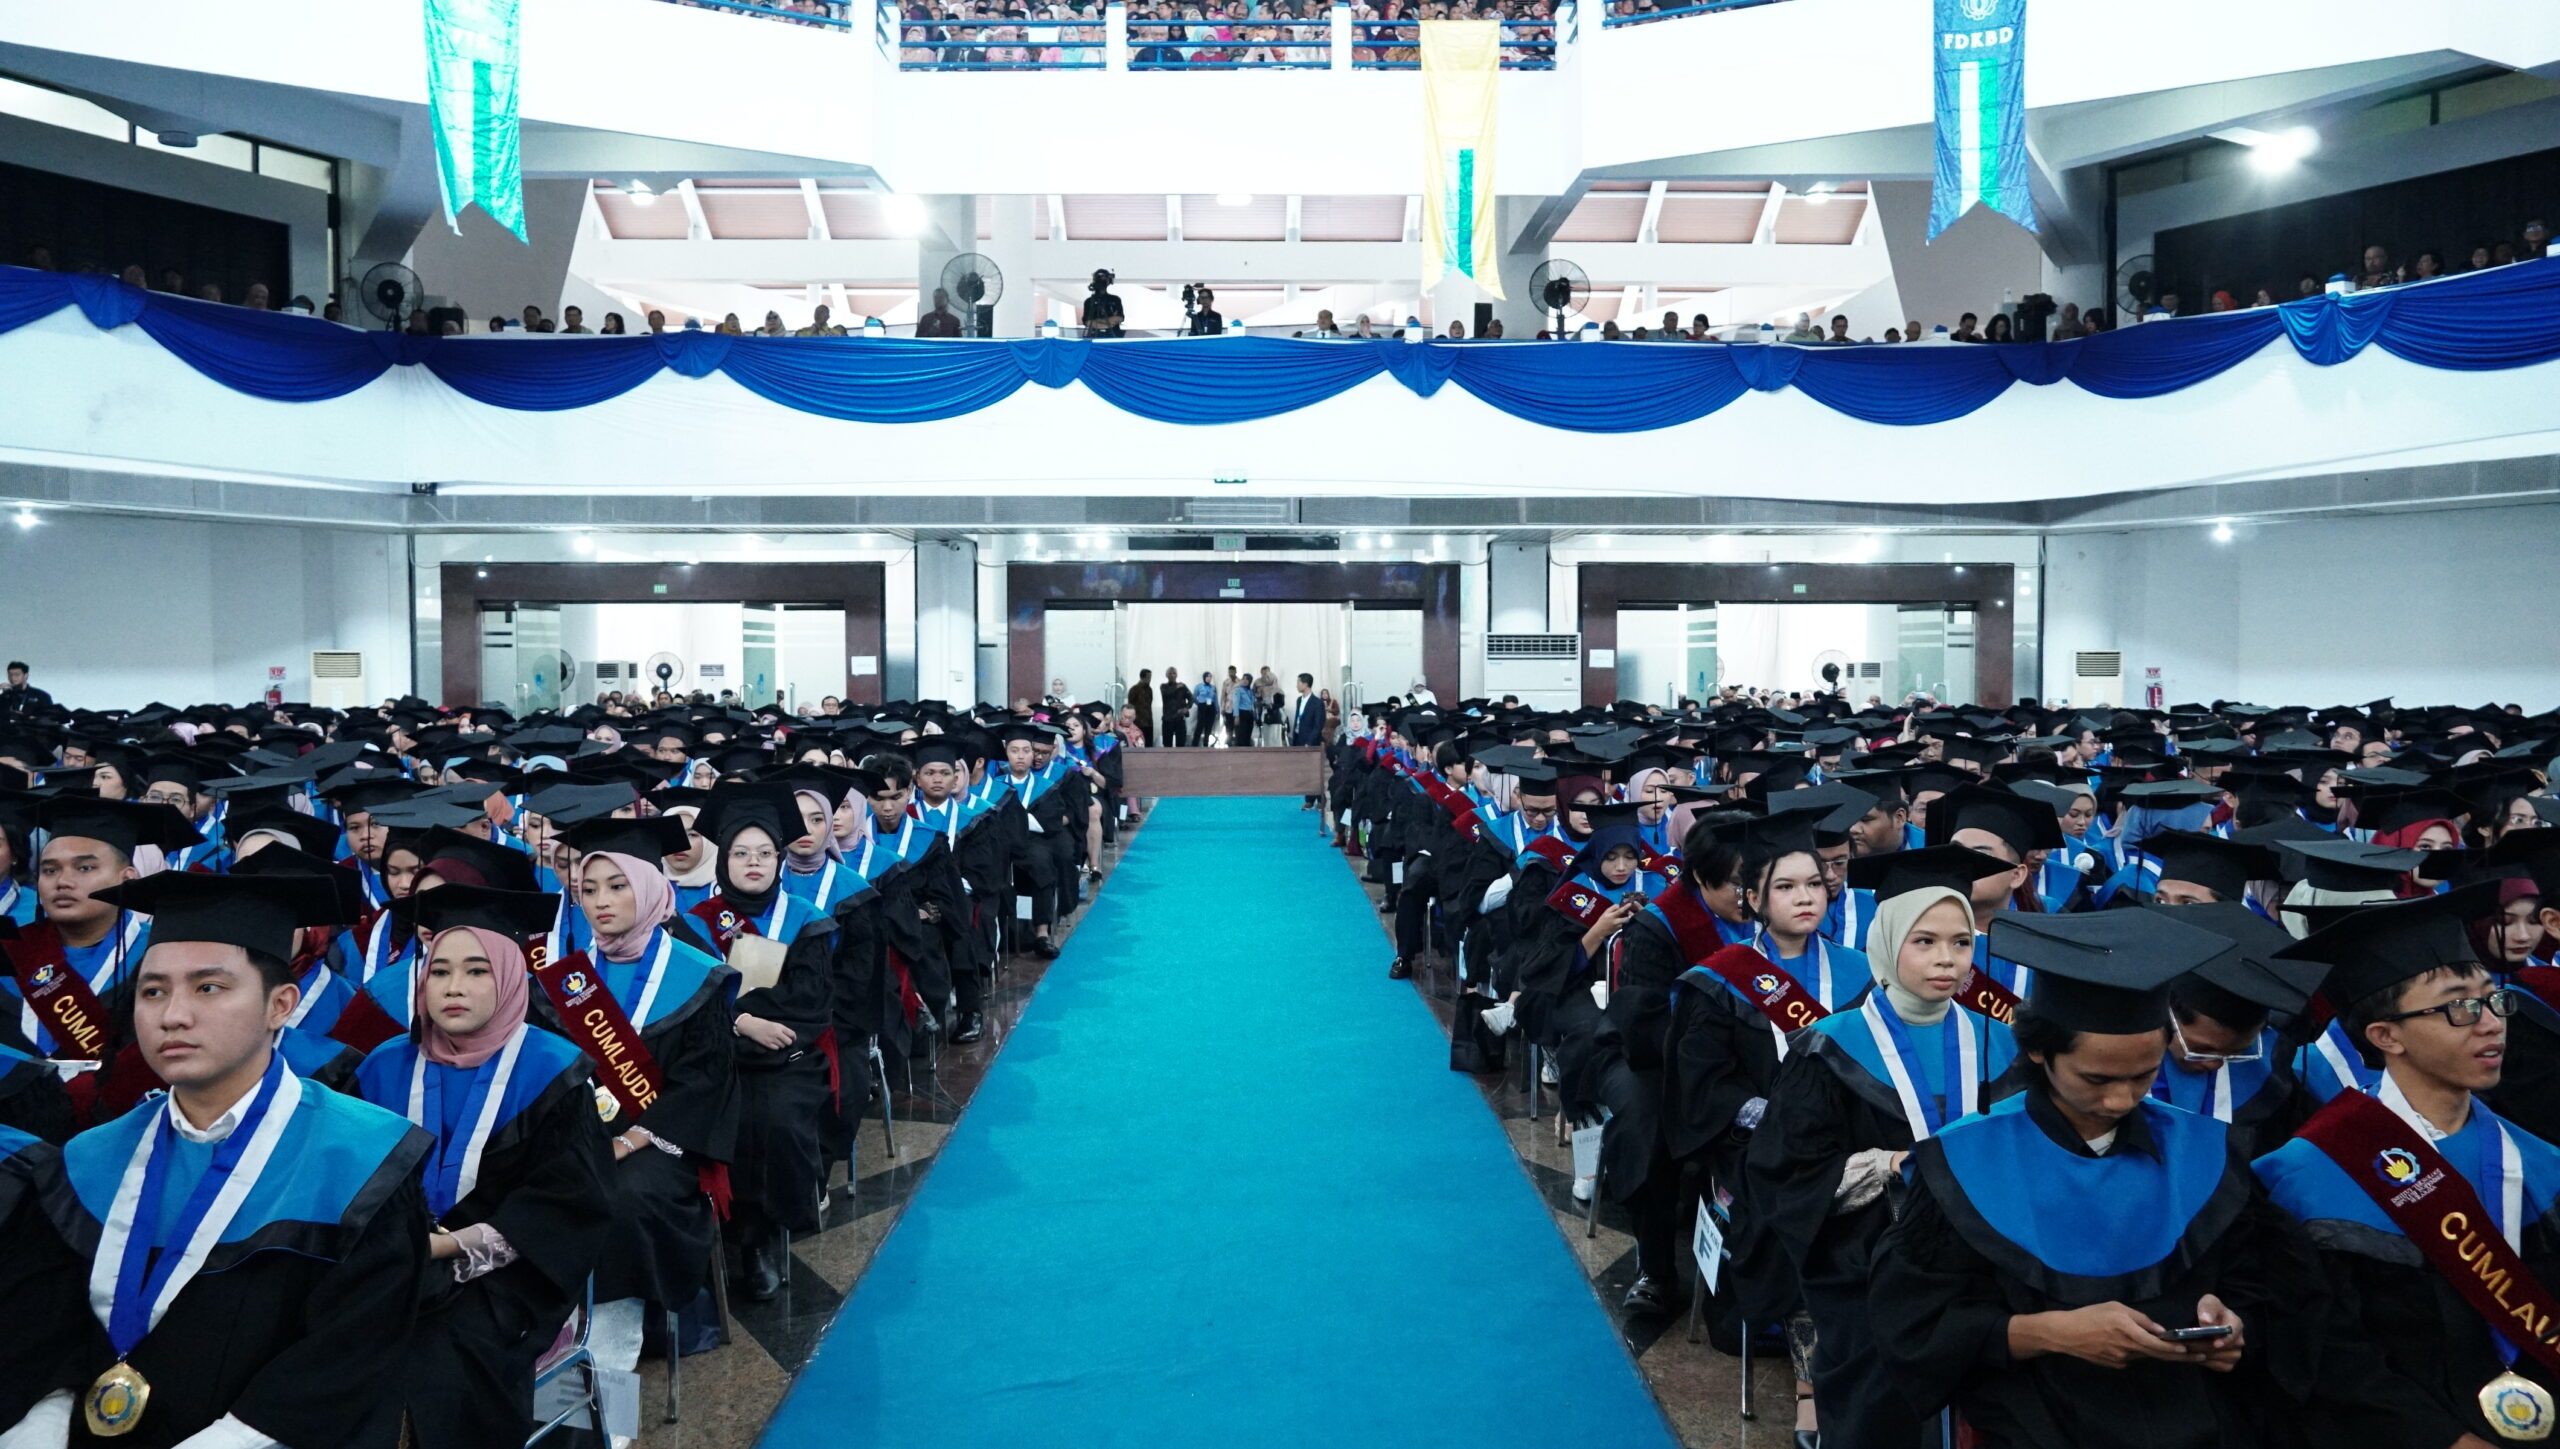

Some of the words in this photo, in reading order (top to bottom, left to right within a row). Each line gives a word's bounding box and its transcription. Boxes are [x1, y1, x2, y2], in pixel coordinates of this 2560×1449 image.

[1944, 26, 2014, 50] FDKBD
[583, 1009, 658, 1111] CUMLAUDE
[1698, 1229, 1712, 1260] F
